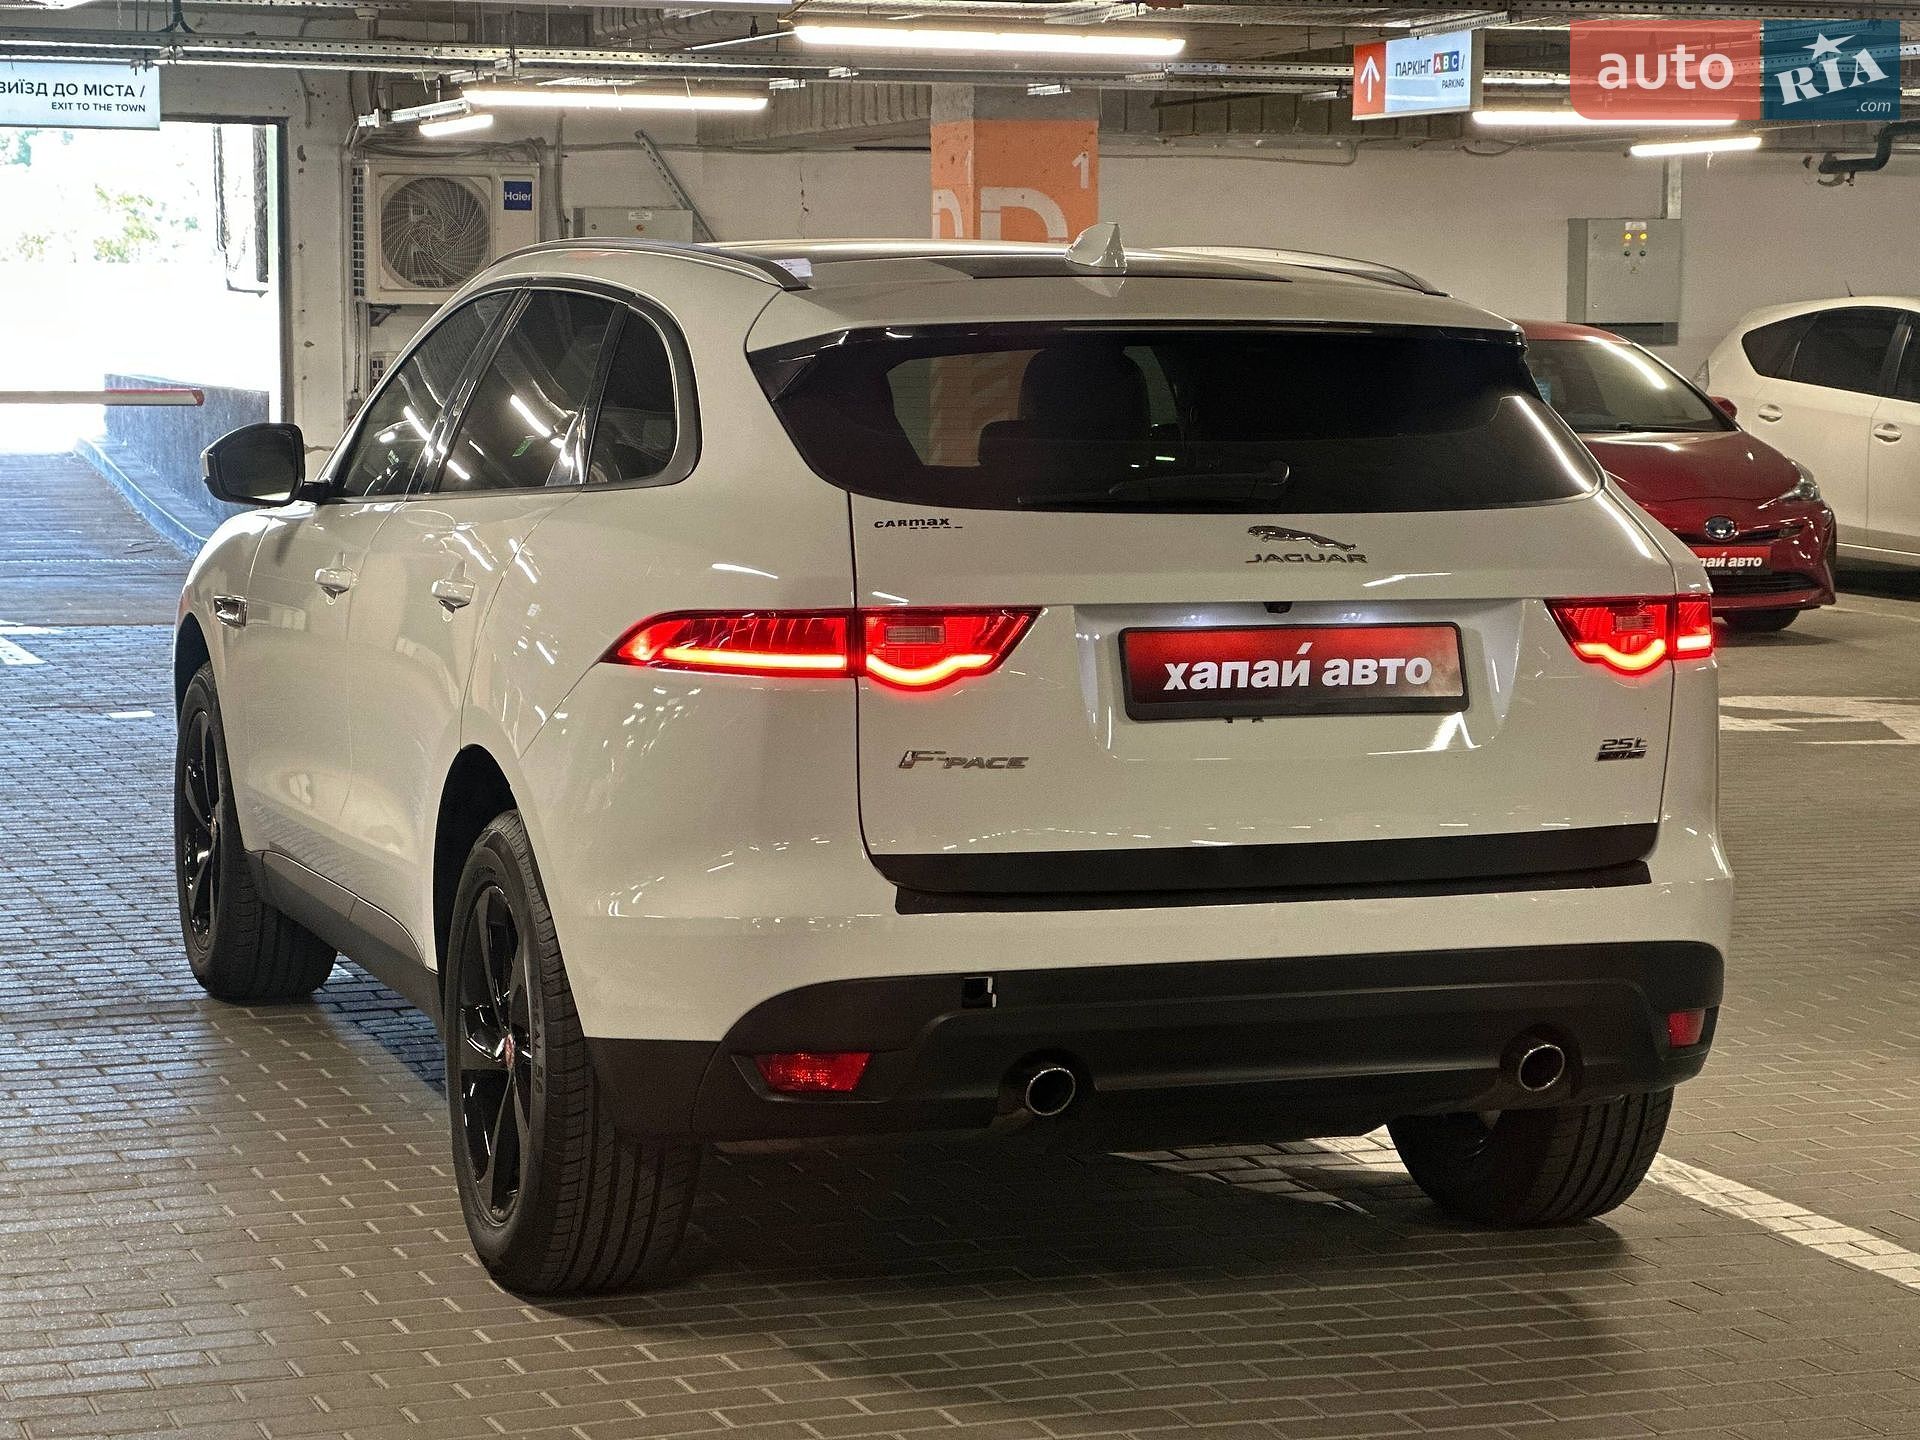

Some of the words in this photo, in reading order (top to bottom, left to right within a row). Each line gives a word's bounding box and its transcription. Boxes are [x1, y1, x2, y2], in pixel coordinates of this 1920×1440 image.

[1395, 59, 1431, 76] ПАРКІНГ
[1442, 78, 1464, 89] PARKING
[53, 83, 78, 97] ДО
[84, 84, 135, 97] МІСТА
[51, 102, 73, 110] EXIT
[77, 103, 90, 111] TO
[94, 103, 112, 111] THE
[116, 104, 146, 112] TOWN
[1072, 151, 1089, 189] 1
[504, 191, 532, 201] Haier
[1245, 554, 1368, 563] JAGUAR
[1728, 557, 1762, 567] авто
[1321, 657, 1432, 687] авто
